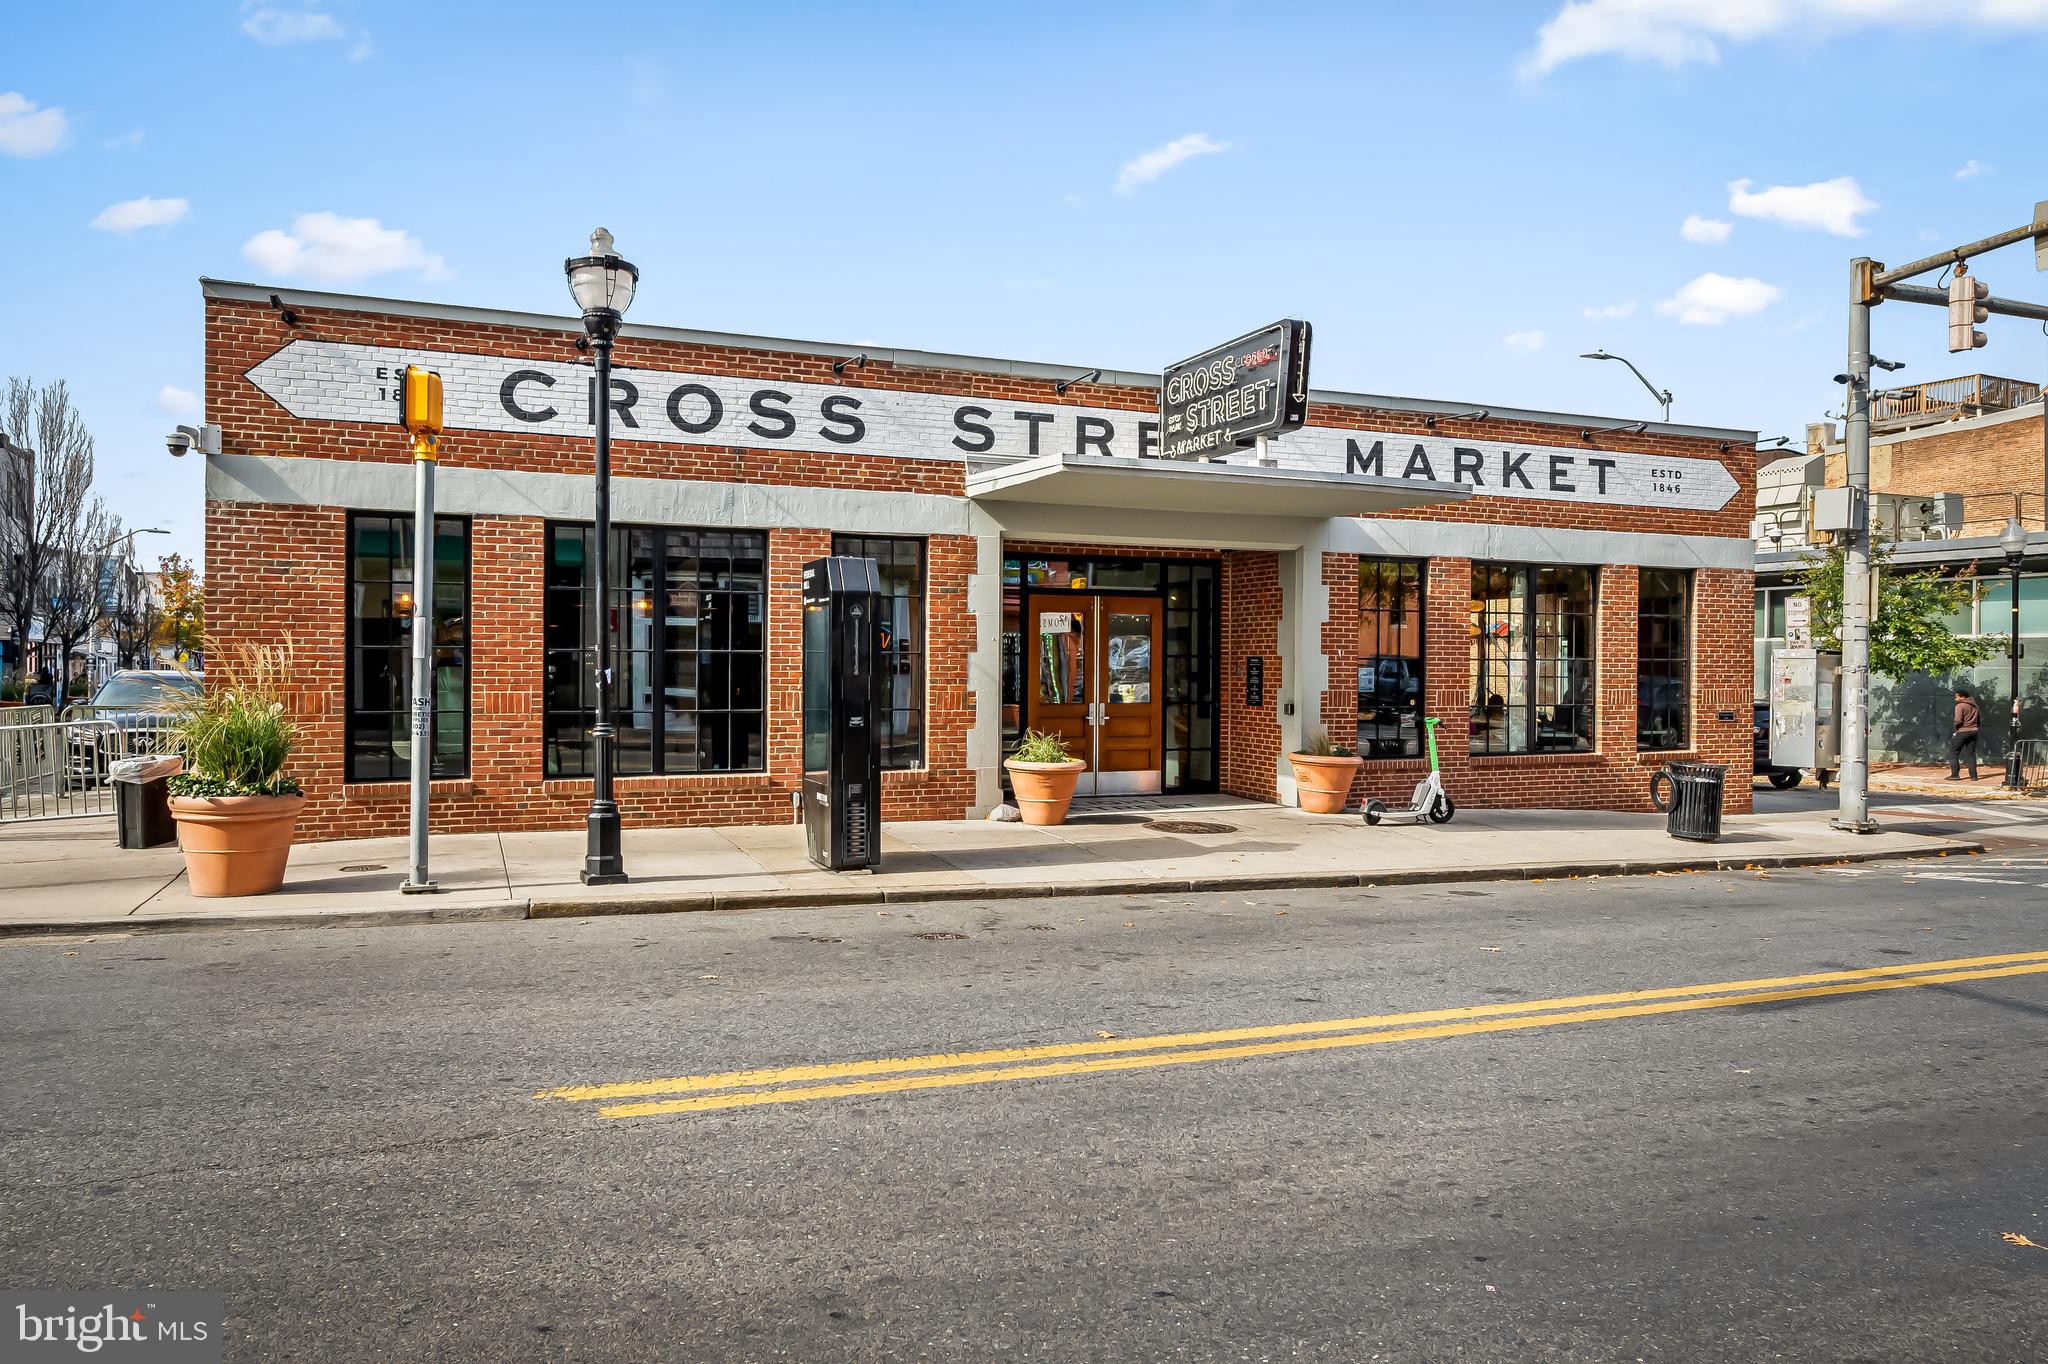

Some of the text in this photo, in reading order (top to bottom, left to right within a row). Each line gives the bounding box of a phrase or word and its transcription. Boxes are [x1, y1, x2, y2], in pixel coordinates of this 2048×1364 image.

[376, 366, 405, 381] ES
[1167, 355, 1236, 405] CROSS
[378, 387, 401, 402] 18
[1185, 378, 1271, 433] STREET
[500, 369, 1616, 495] CROSS STRE MARKET
[1176, 429, 1222, 455] MARKET
[1651, 468, 1683, 480] ESTD
[1652, 482, 1682, 494] 1846
[412, 697, 430, 706] ASH
